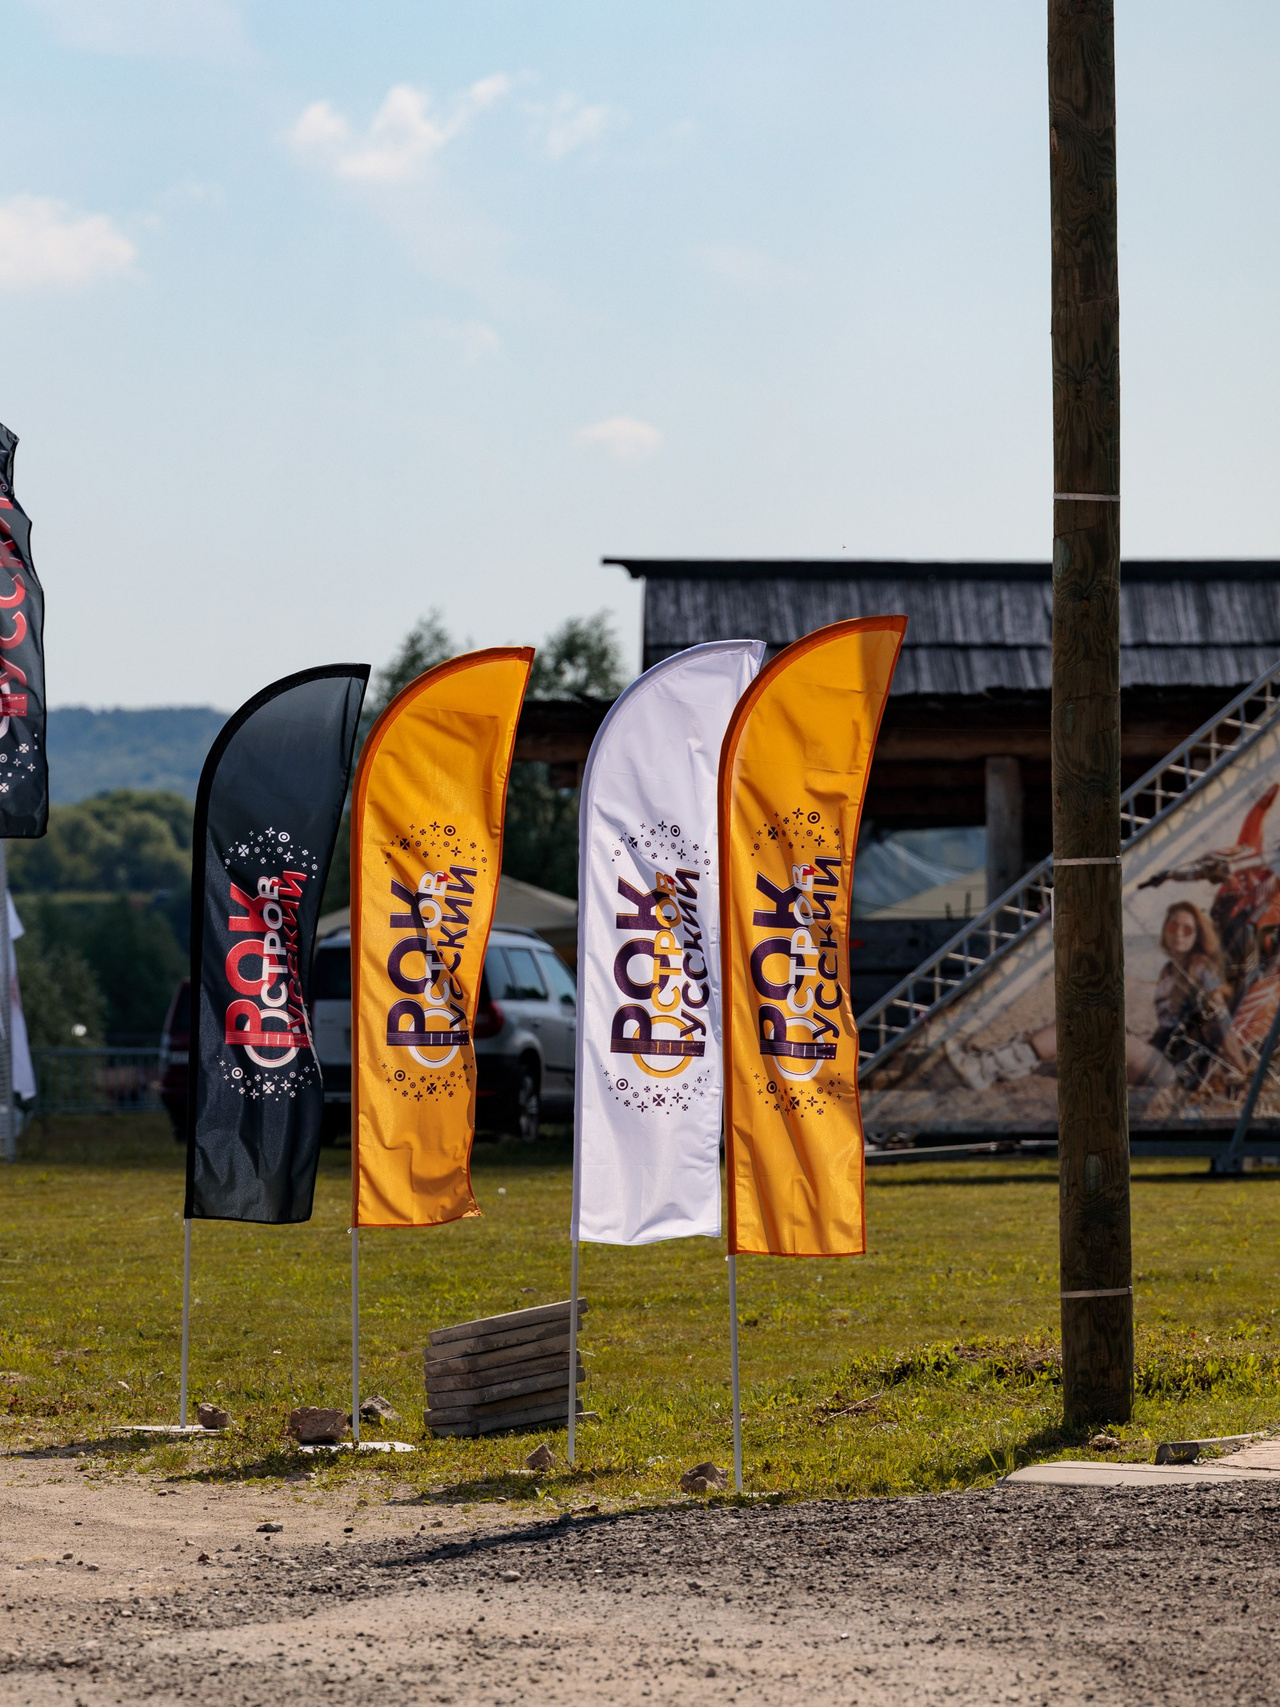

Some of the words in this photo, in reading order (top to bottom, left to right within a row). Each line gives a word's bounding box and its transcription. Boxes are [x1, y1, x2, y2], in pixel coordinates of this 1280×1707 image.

[225, 882, 310, 1049] РОК
[243, 876, 301, 1068] ОСТРОВ
[387, 877, 469, 1046] РОК
[408, 871, 461, 1069] ОСТОВ
[610, 876, 705, 1058] РОК
[631, 871, 695, 1079] ОСТРОВ
[750, 871, 837, 1060] РОК
[770, 864, 825, 1081] ОСТРОВ
